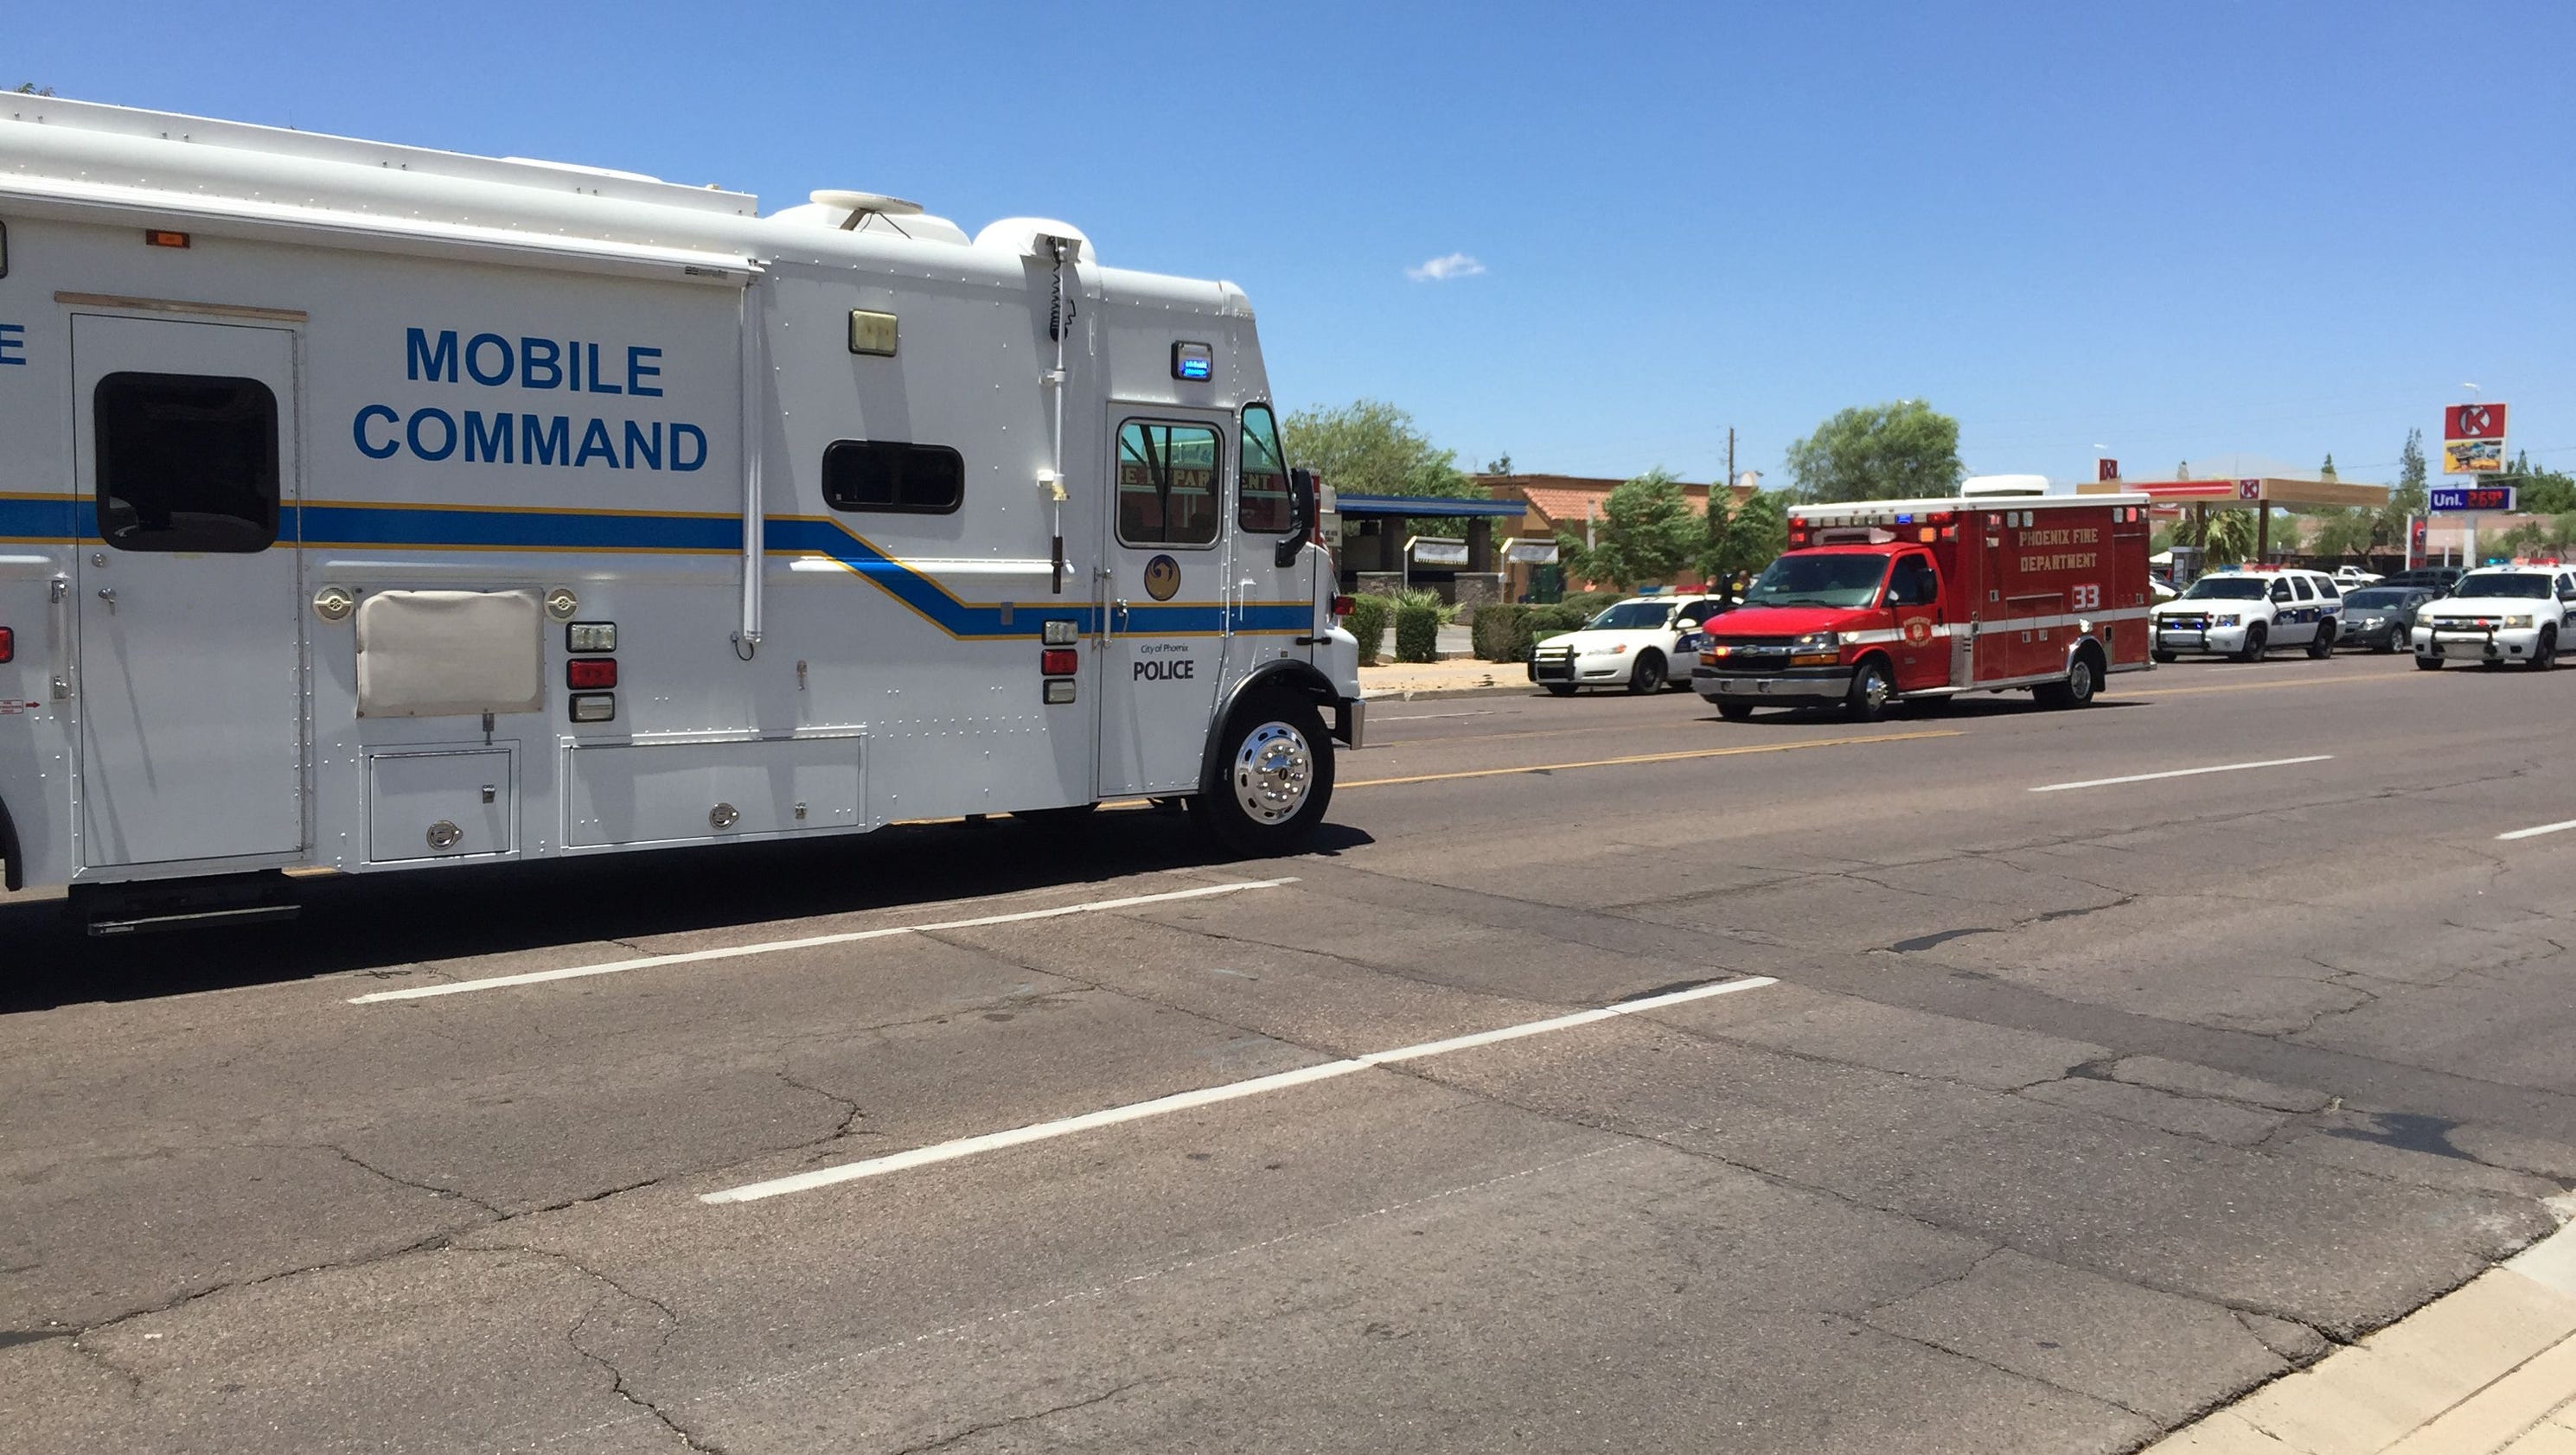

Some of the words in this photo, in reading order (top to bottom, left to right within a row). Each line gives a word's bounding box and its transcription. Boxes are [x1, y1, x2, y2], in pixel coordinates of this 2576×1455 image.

[406, 328, 663, 397] MOBILE
[353, 404, 708, 472] COMMAND
[2019, 529, 2070, 546] PHOENIX
[2073, 528, 2099, 544] FIRE
[2020, 553, 2096, 572] DEPARTMENT
[2074, 585, 2100, 609] 33
[1141, 644, 1154, 654] City
[1155, 643, 1162, 653] of
[1163, 643, 1189, 653] Phoenix
[1134, 660, 1194, 681] POLICE
